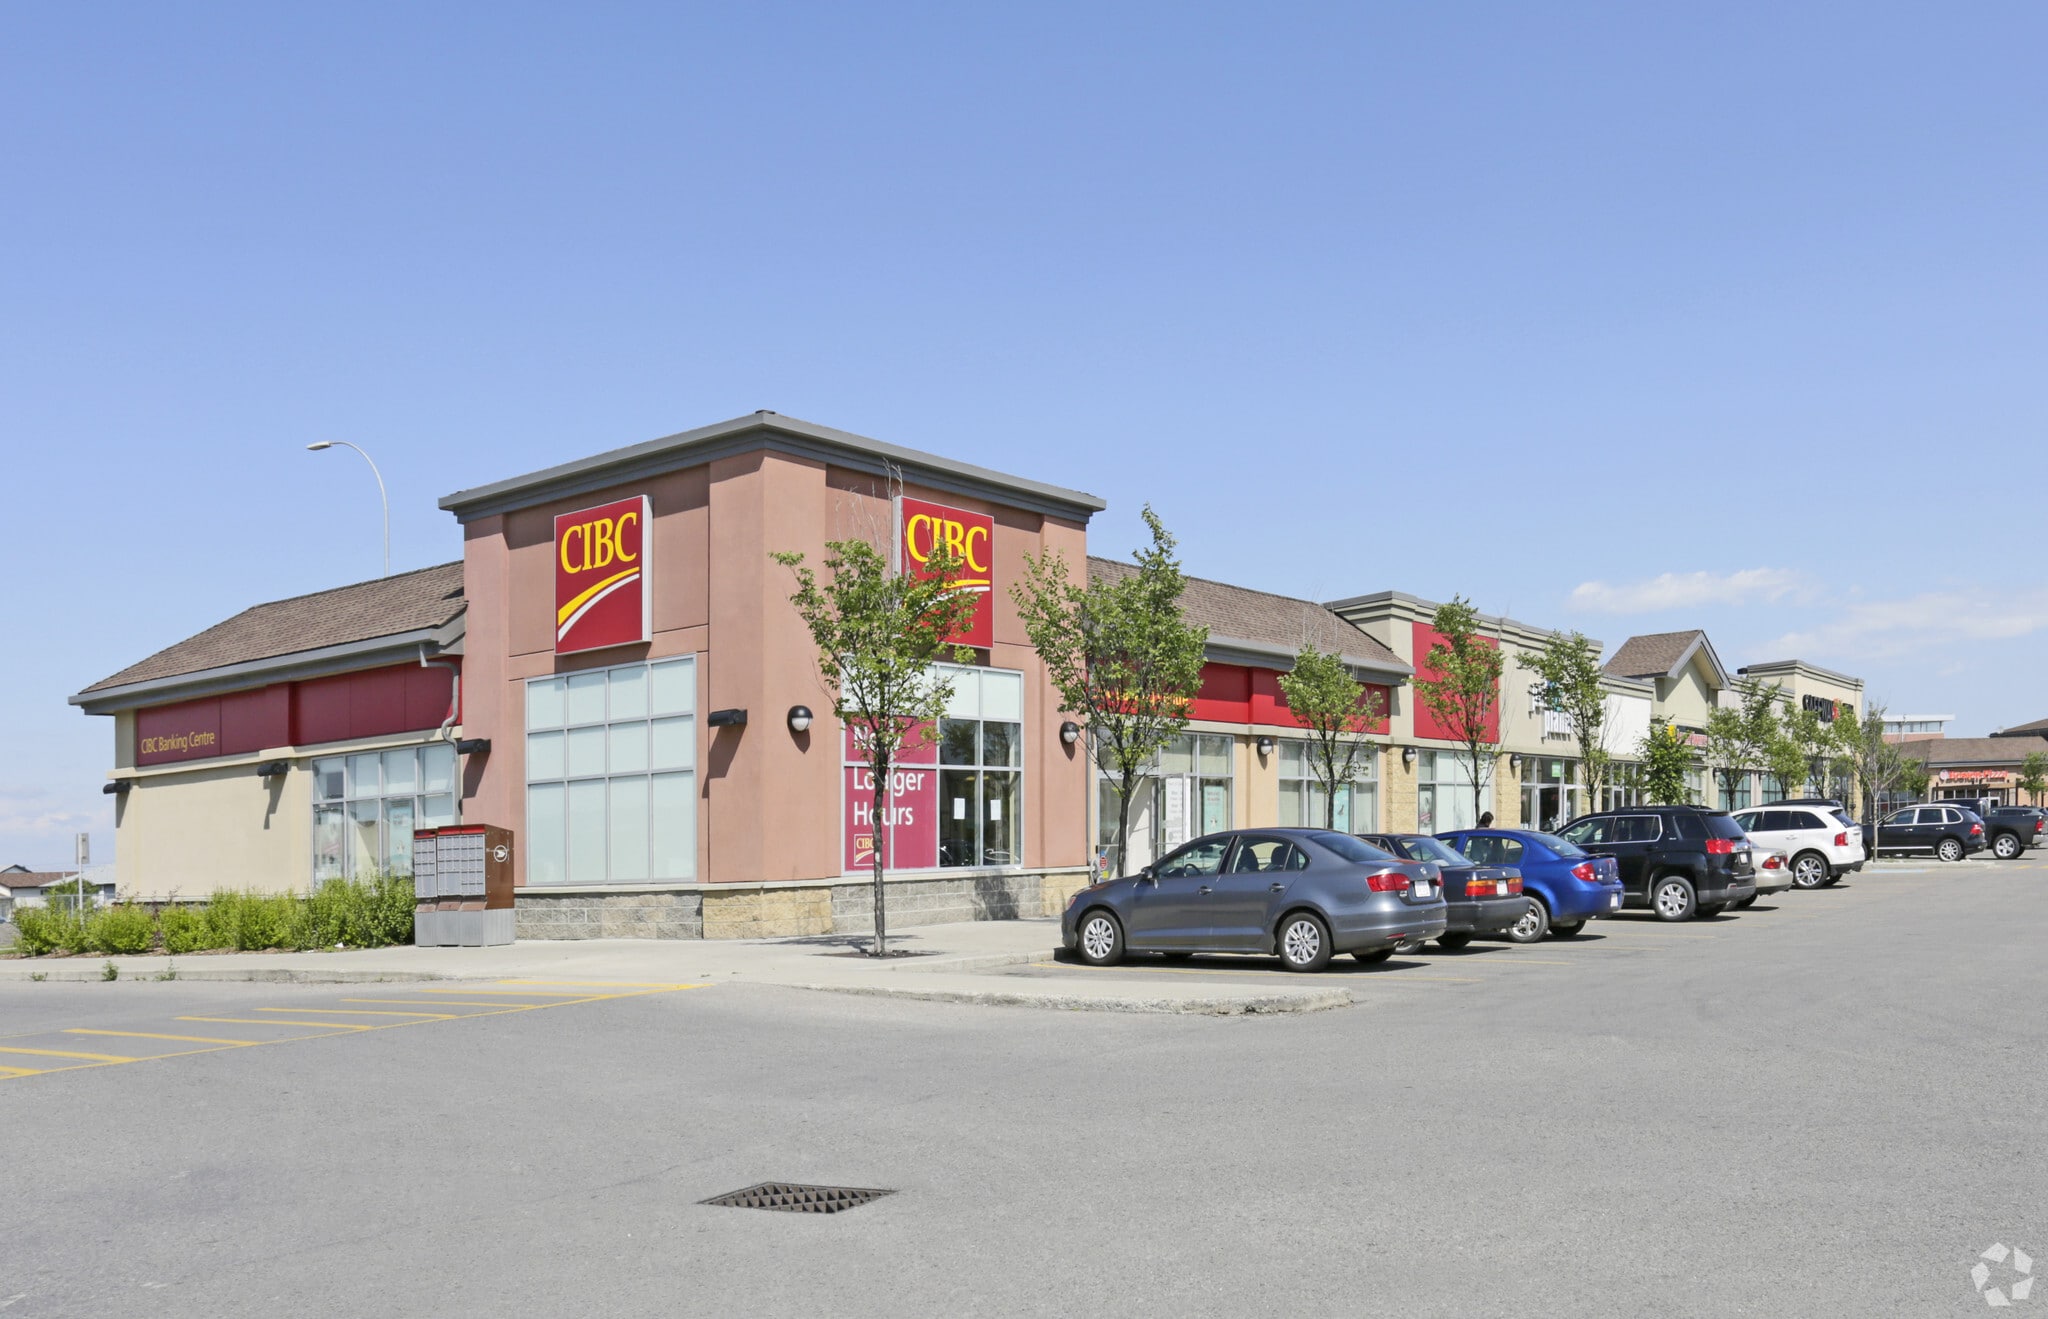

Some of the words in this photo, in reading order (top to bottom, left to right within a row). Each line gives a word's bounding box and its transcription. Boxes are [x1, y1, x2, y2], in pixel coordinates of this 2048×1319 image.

[561, 512, 637, 574] CIBC
[907, 513, 987, 573] CIBC
[141, 738, 158, 754] CIBC
[159, 733, 188, 752] Banking
[189, 731, 215, 747] Centre
